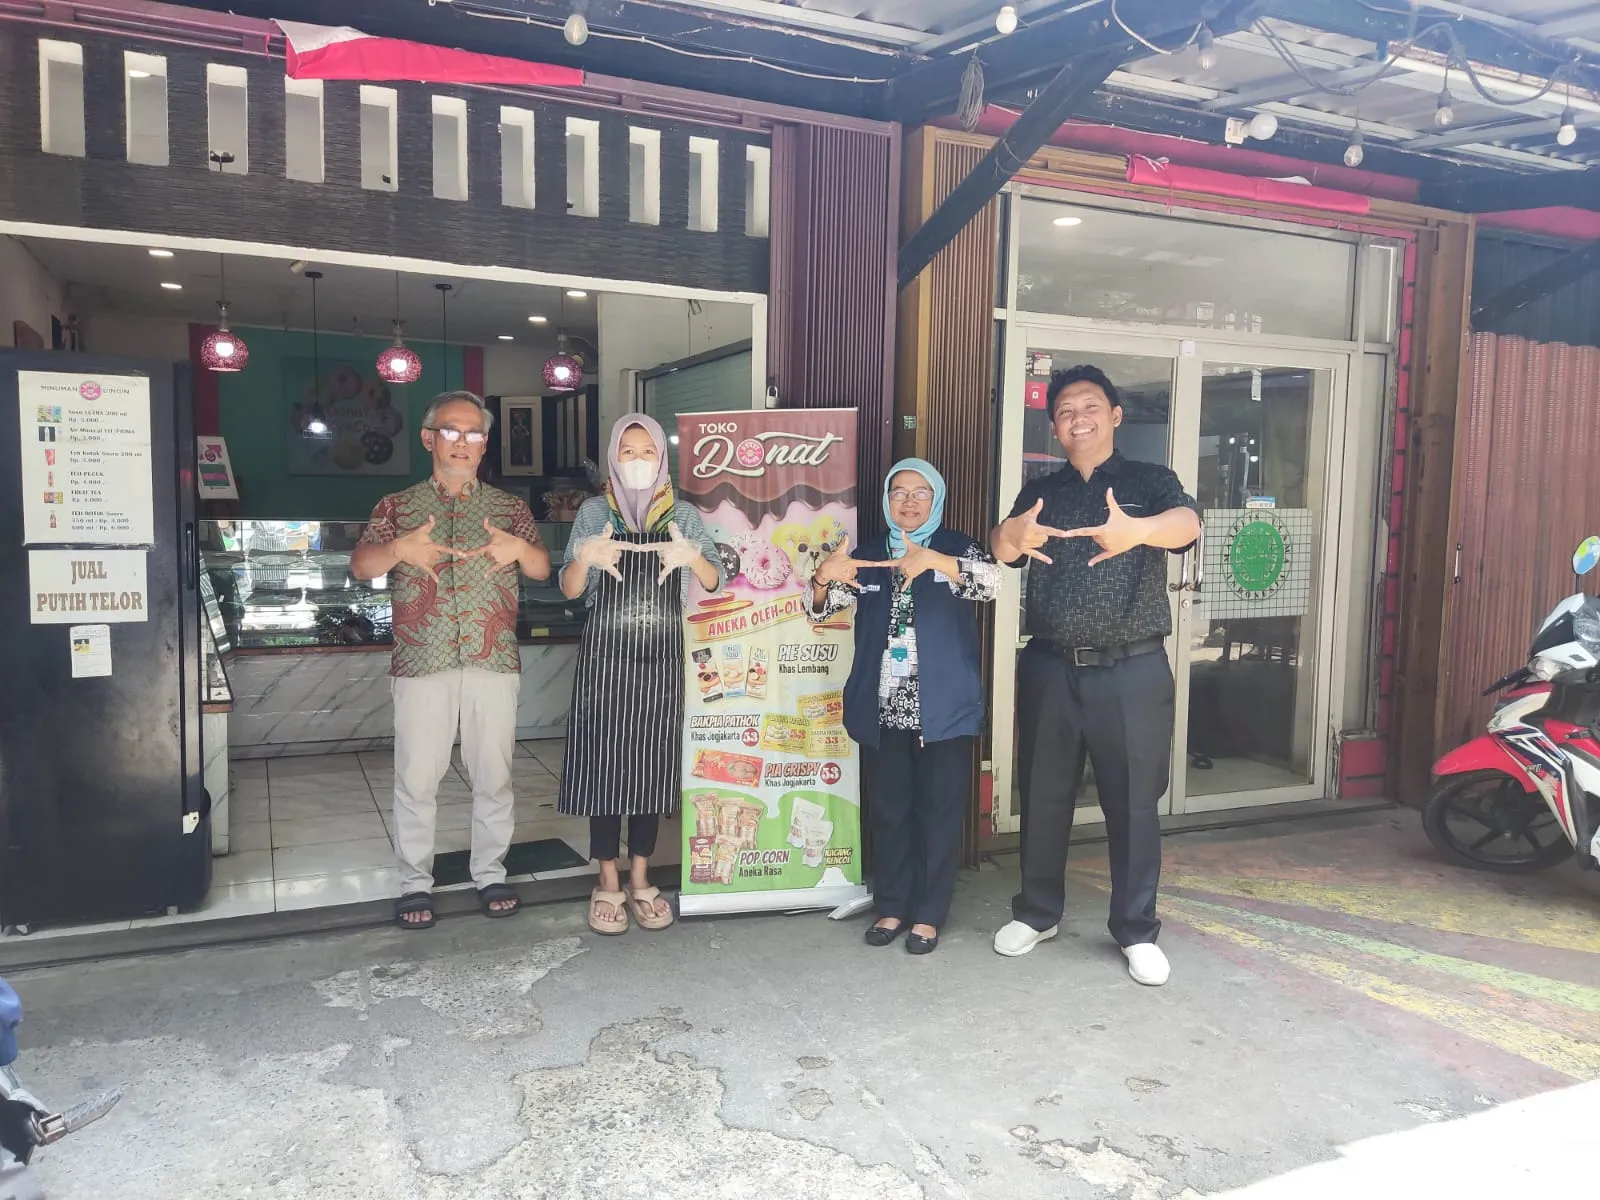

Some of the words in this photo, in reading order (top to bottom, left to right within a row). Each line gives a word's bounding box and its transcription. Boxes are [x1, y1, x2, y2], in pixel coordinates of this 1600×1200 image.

[699, 422, 738, 434] TOKO
[71, 561, 107, 585] JUAL
[36, 592, 87, 612] PUTIH
[89, 591, 143, 611] TELOR
[708, 615, 747, 636] ANEKA
[777, 643, 800, 662] PIE
[800, 643, 839, 662] SUSU
[778, 663, 796, 673] Khas
[797, 663, 829, 675] Lembang
[690, 714, 724, 728] BAKPIA
[724, 713, 760, 728] PATHOK
[690, 731, 706, 741] Khas
[764, 762, 782, 777] PIA
[821, 766, 840, 780] 53
[765, 778, 781, 787] Khas
[782, 778, 816, 788] Jogjakarta
[739, 850, 760, 866] POP
[761, 849, 791, 865] CORN
[739, 866, 762, 877] Aneka
[763, 865, 782, 877] Rasa
